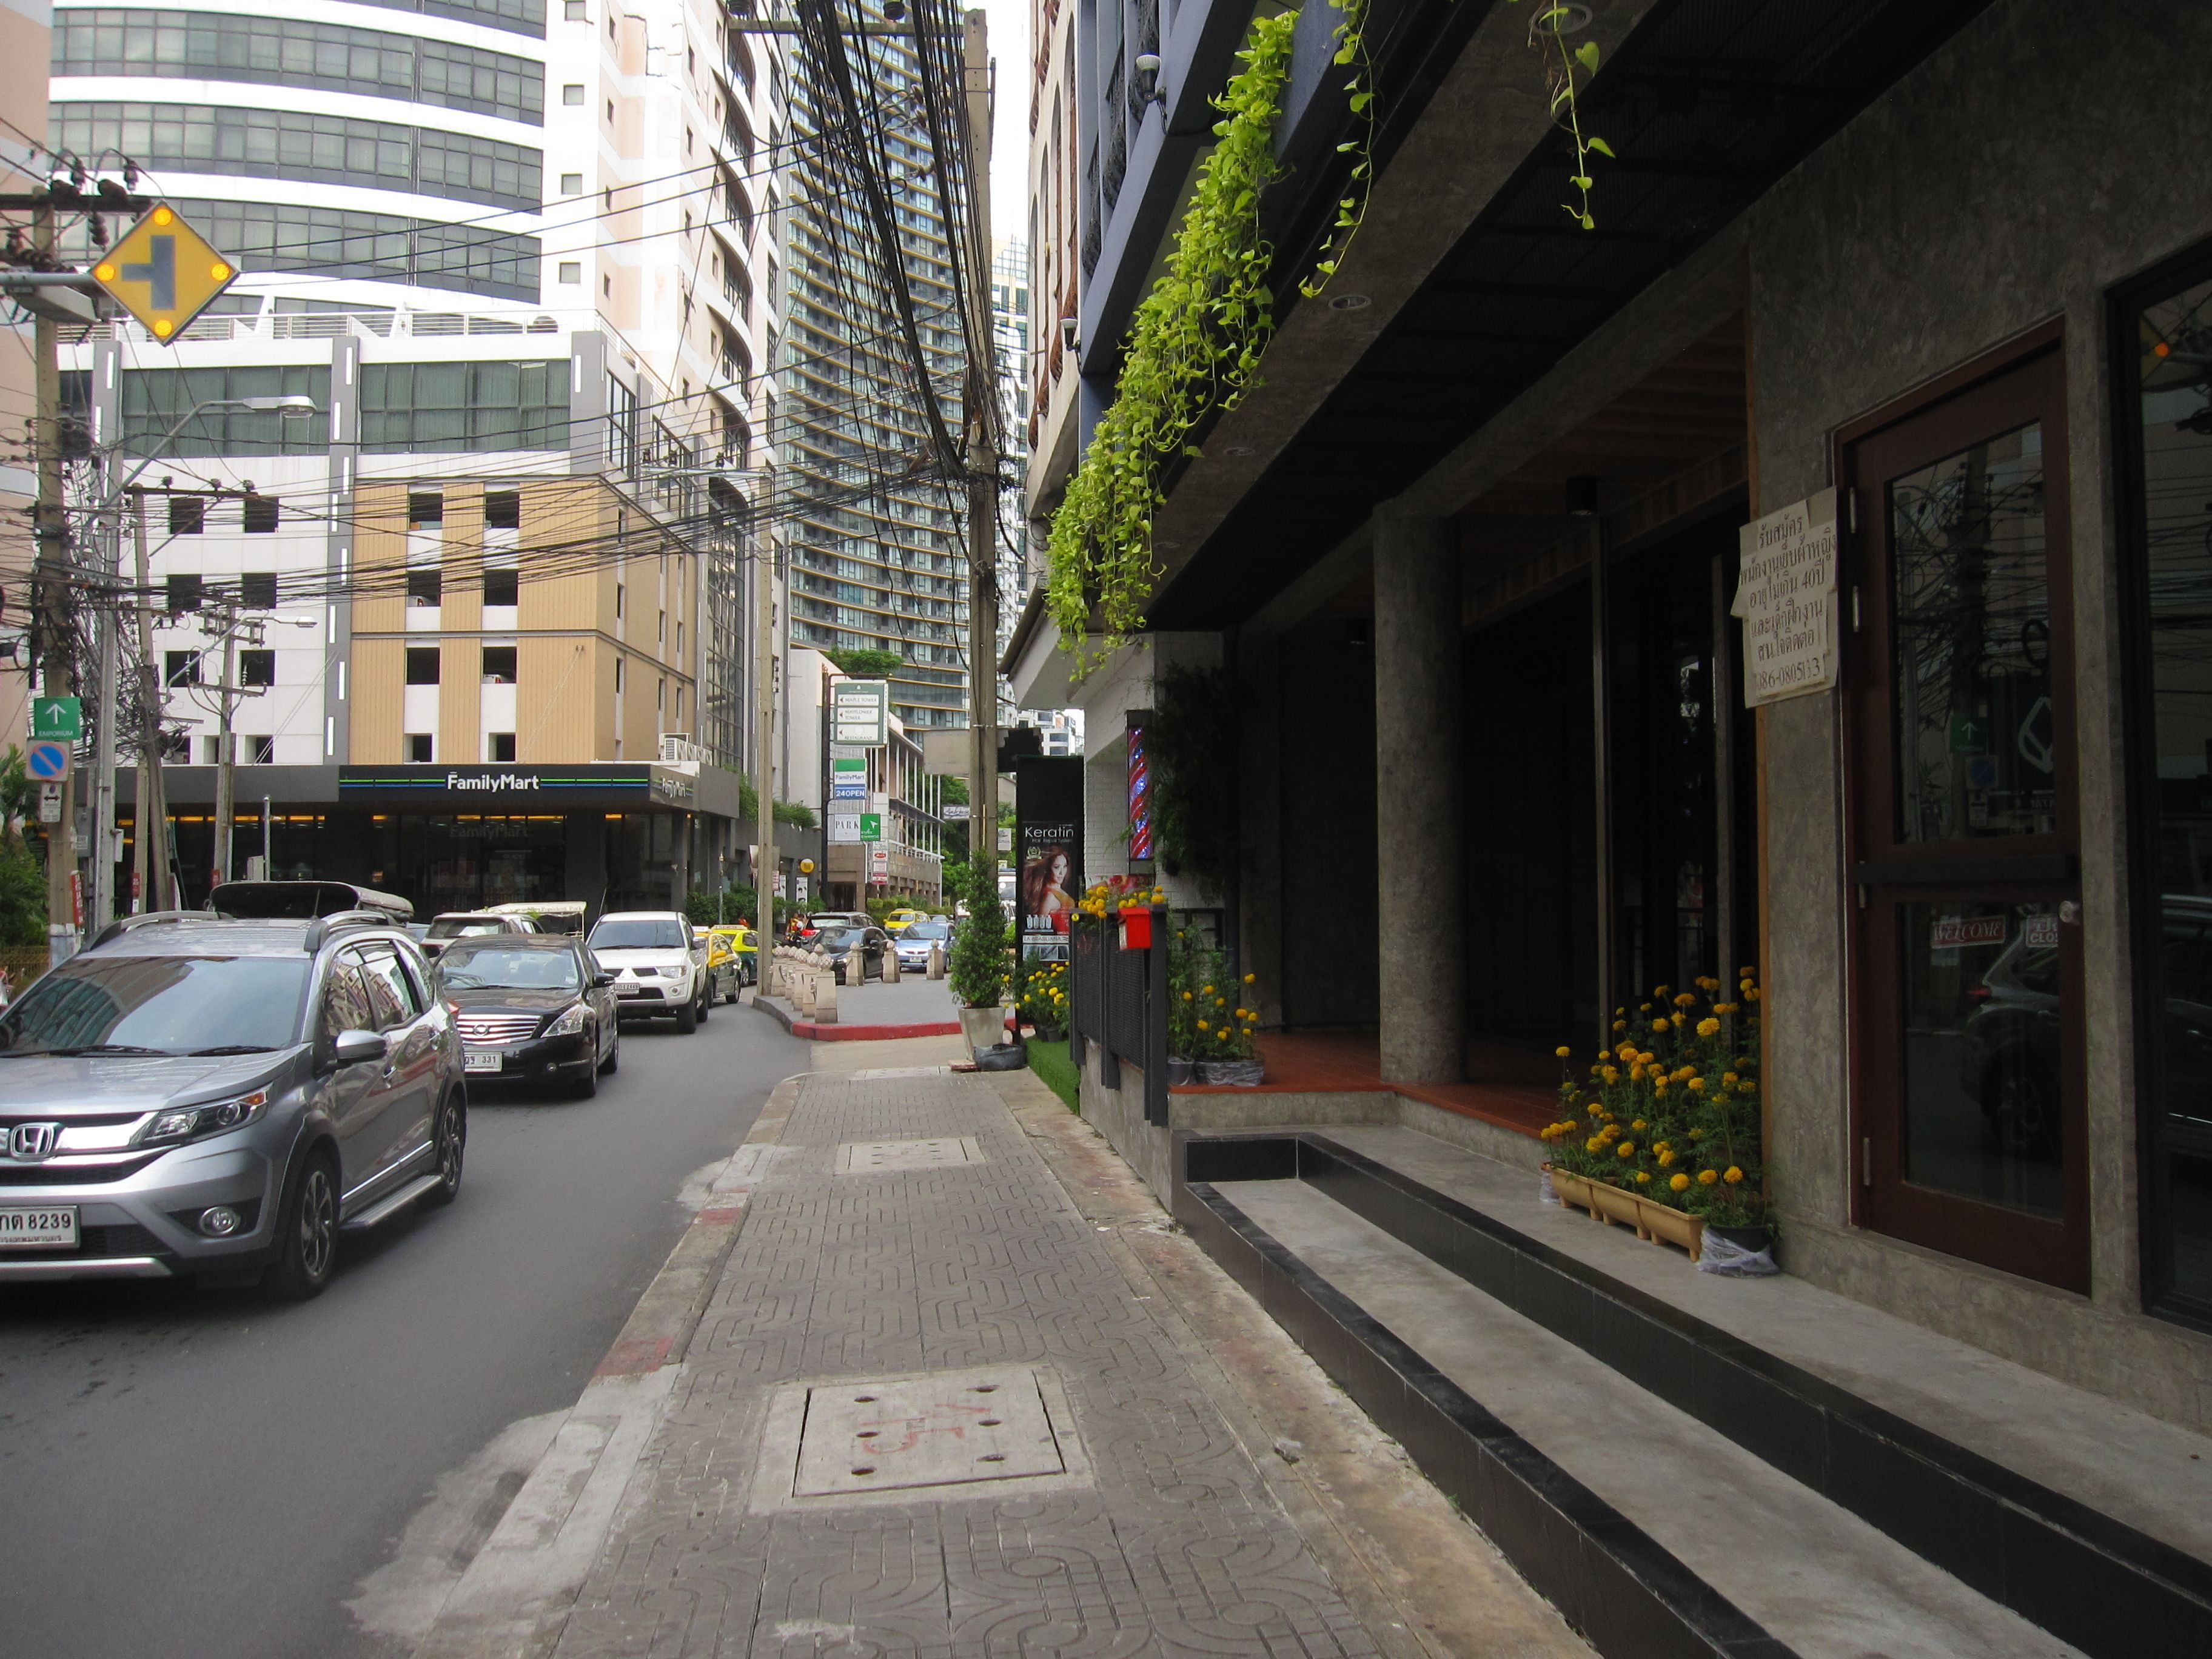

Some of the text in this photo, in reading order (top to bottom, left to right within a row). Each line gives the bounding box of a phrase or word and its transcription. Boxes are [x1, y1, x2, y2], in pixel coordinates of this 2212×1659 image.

[447, 773, 539, 793] FamilyMart
[836, 820, 859, 830] PARK
[1025, 826, 1074, 837] Keratin
[1934, 921, 2002, 942] WELCOME
[482, 1055, 496, 1064] 331
[28, 1213, 71, 1230] 8239
